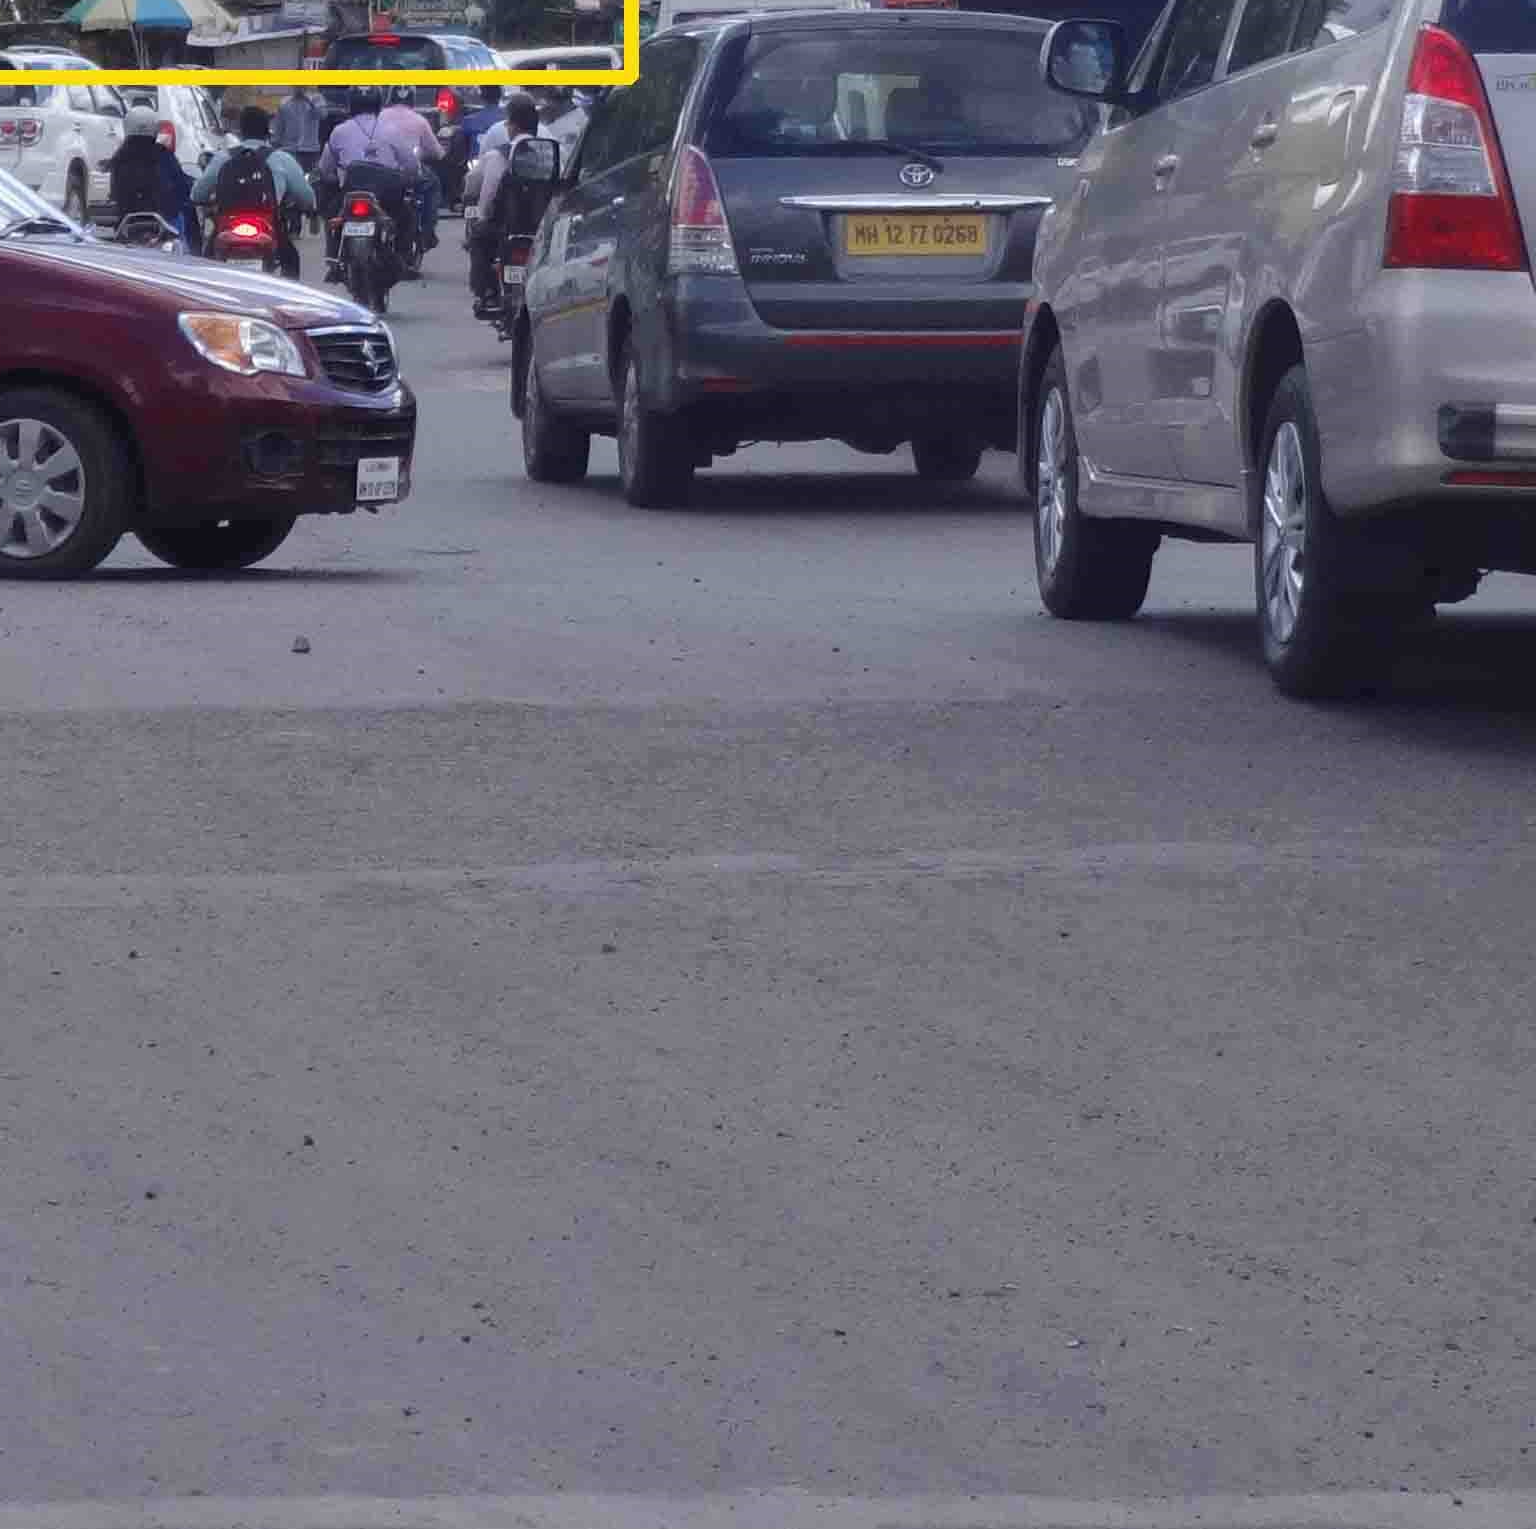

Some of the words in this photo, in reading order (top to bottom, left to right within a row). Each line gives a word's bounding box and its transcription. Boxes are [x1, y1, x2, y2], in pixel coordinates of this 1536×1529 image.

[854, 224, 880, 246] MH
[886, 224, 905, 245] 12
[932, 223, 978, 245] 0268
